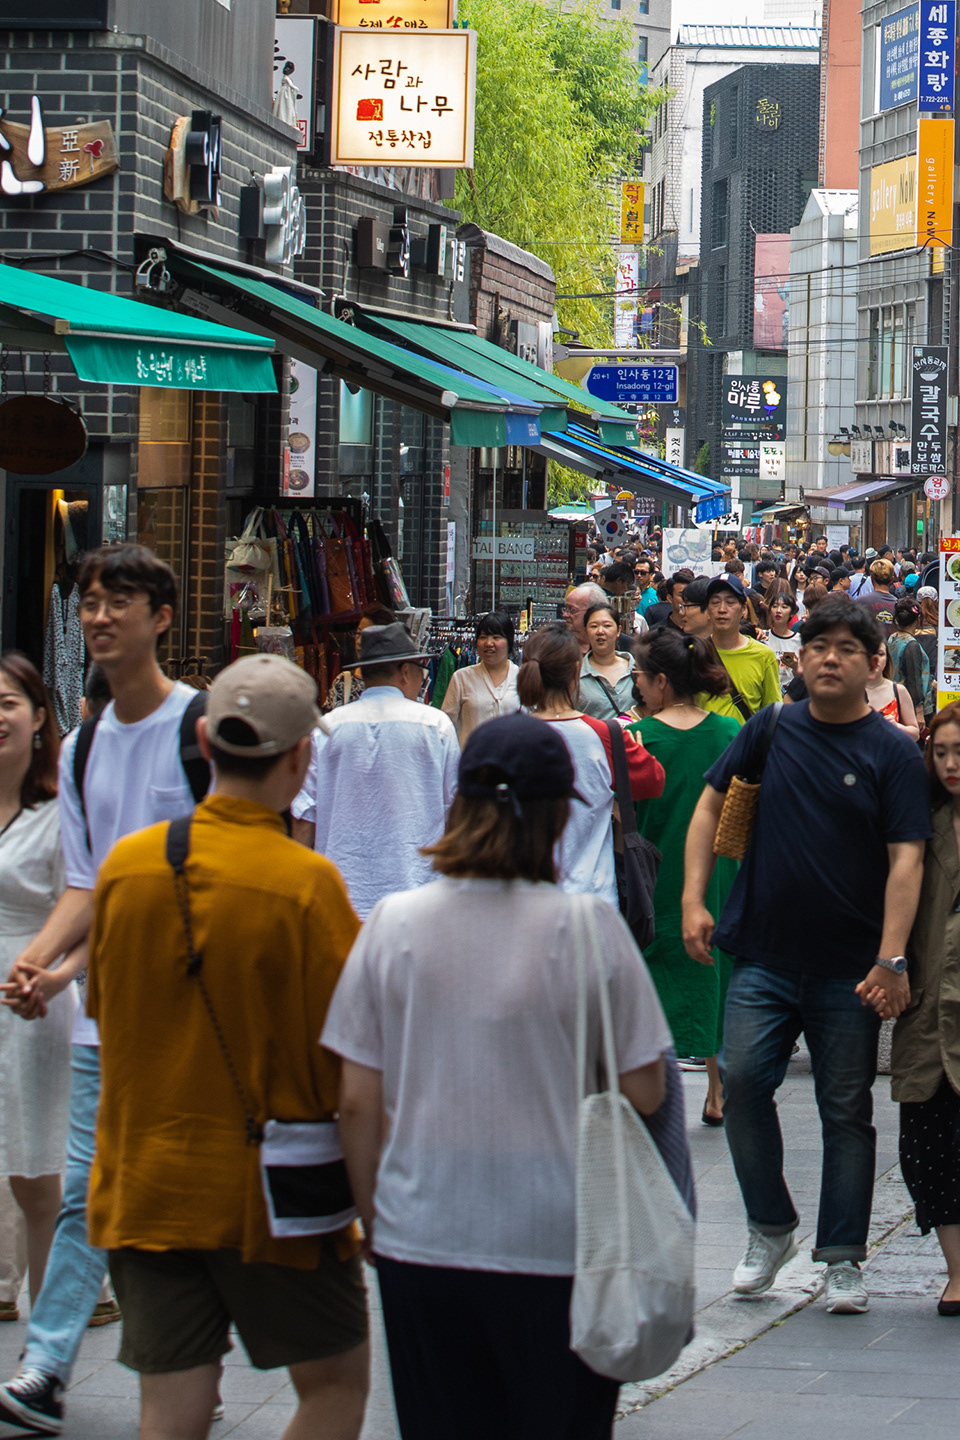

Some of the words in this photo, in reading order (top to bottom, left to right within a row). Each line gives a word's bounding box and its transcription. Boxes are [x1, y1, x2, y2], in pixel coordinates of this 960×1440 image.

[924, 4, 950, 92] 세종화랑
[351, 59, 423, 89] 사람과
[400, 95, 454, 117] 나무
[368, 129, 432, 149] 전통찻집
[925, 158, 937, 205] gallery
[872, 178, 898, 222] gallery
[617, 369, 674, 380] 인사동12길
[616, 382, 651, 391] Insadong
[653, 382, 674, 391] 12-gil
[731, 380, 760, 393] 인사동
[727, 392, 761, 414] 마루
[919, 385, 941, 441] 칼국수
[917, 441, 941, 452] 만두
[917, 453, 941, 463] 보쌈
[911, 463, 945, 473] 왕돈까스
[931, 478, 943, 488] 왕
[498, 542, 533, 555] BANG
